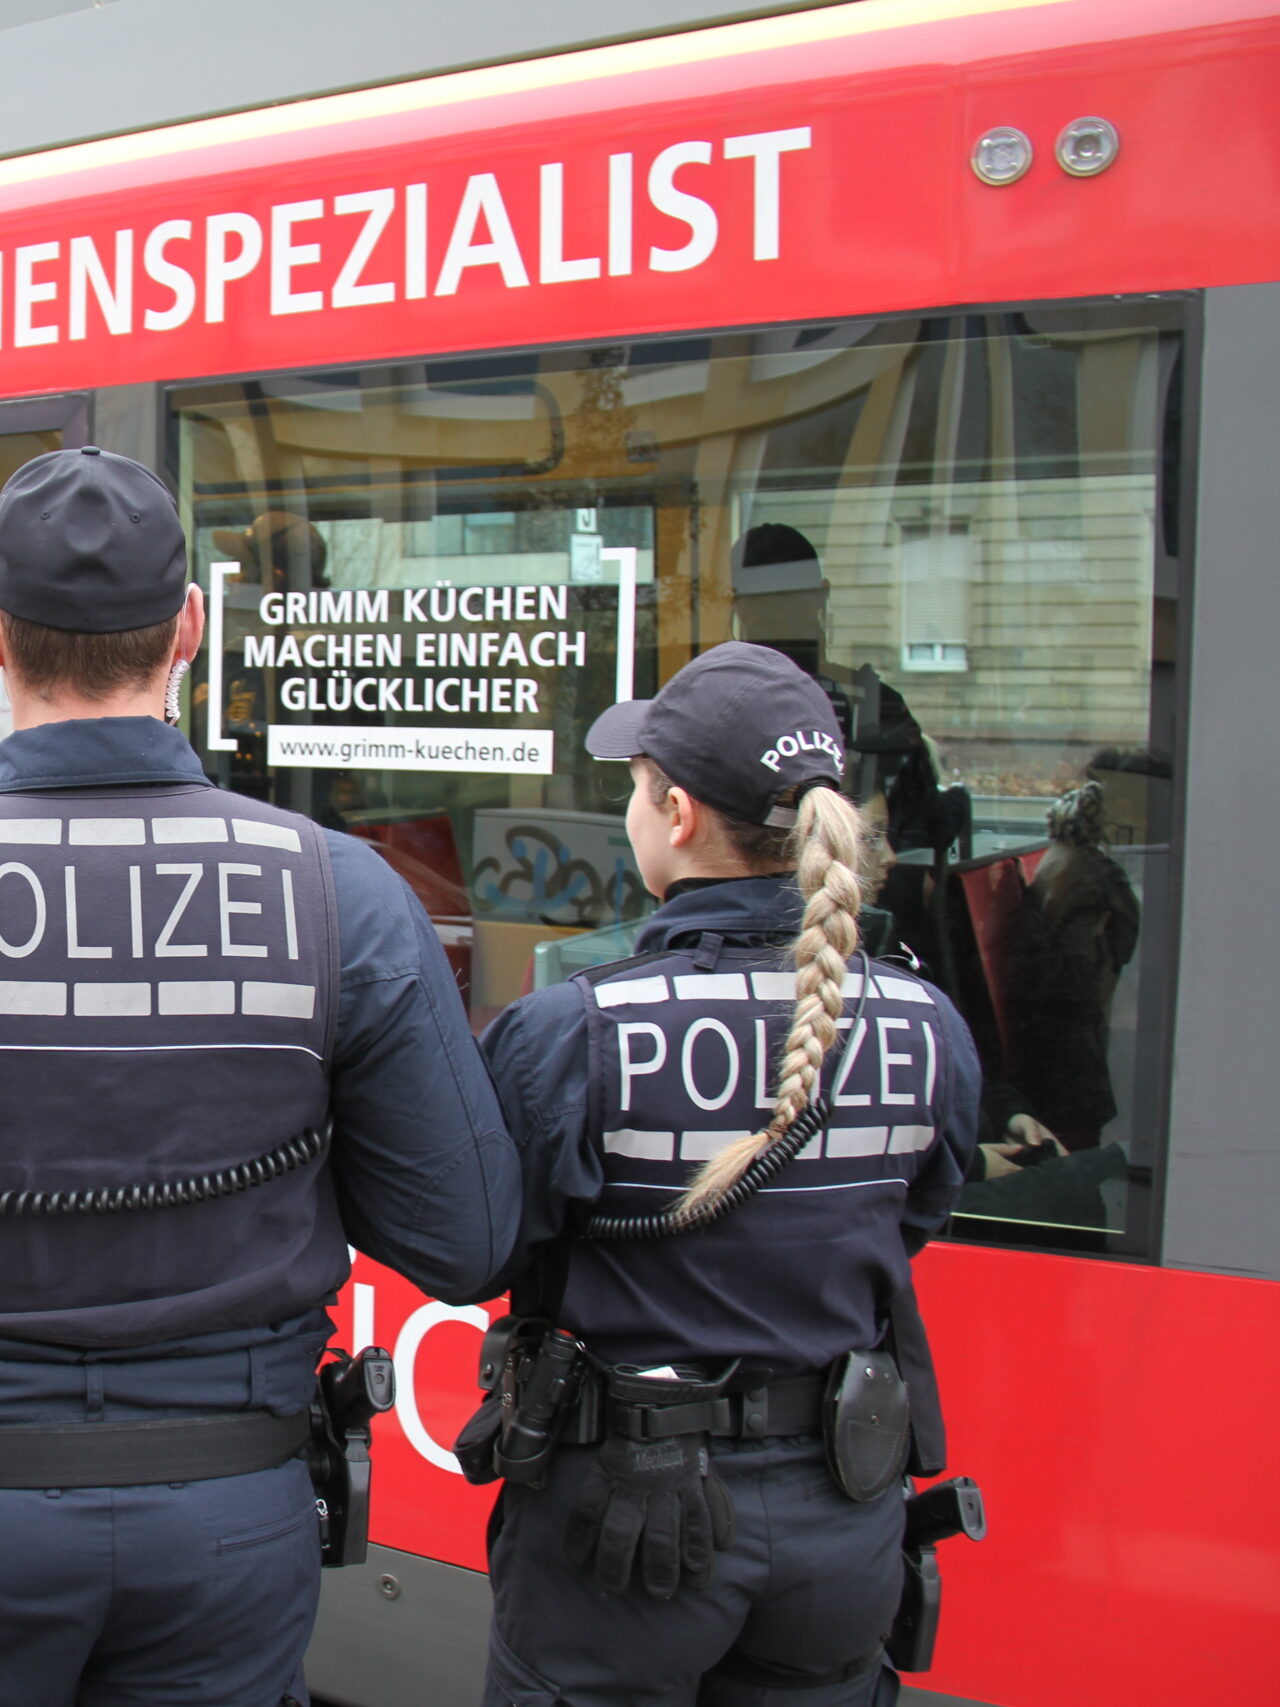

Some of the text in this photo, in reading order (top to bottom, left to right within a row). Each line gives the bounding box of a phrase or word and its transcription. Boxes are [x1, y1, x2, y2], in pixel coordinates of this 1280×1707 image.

[259, 580, 568, 625] GRIMM KÜCHEN
[243, 631, 587, 668] MACHEN EINFACH
[280, 670, 540, 714] GLÜCKLICHER
[280, 739, 540, 763] www.grimm-kuechen.de
[617, 1016, 937, 1112] POLZEI
